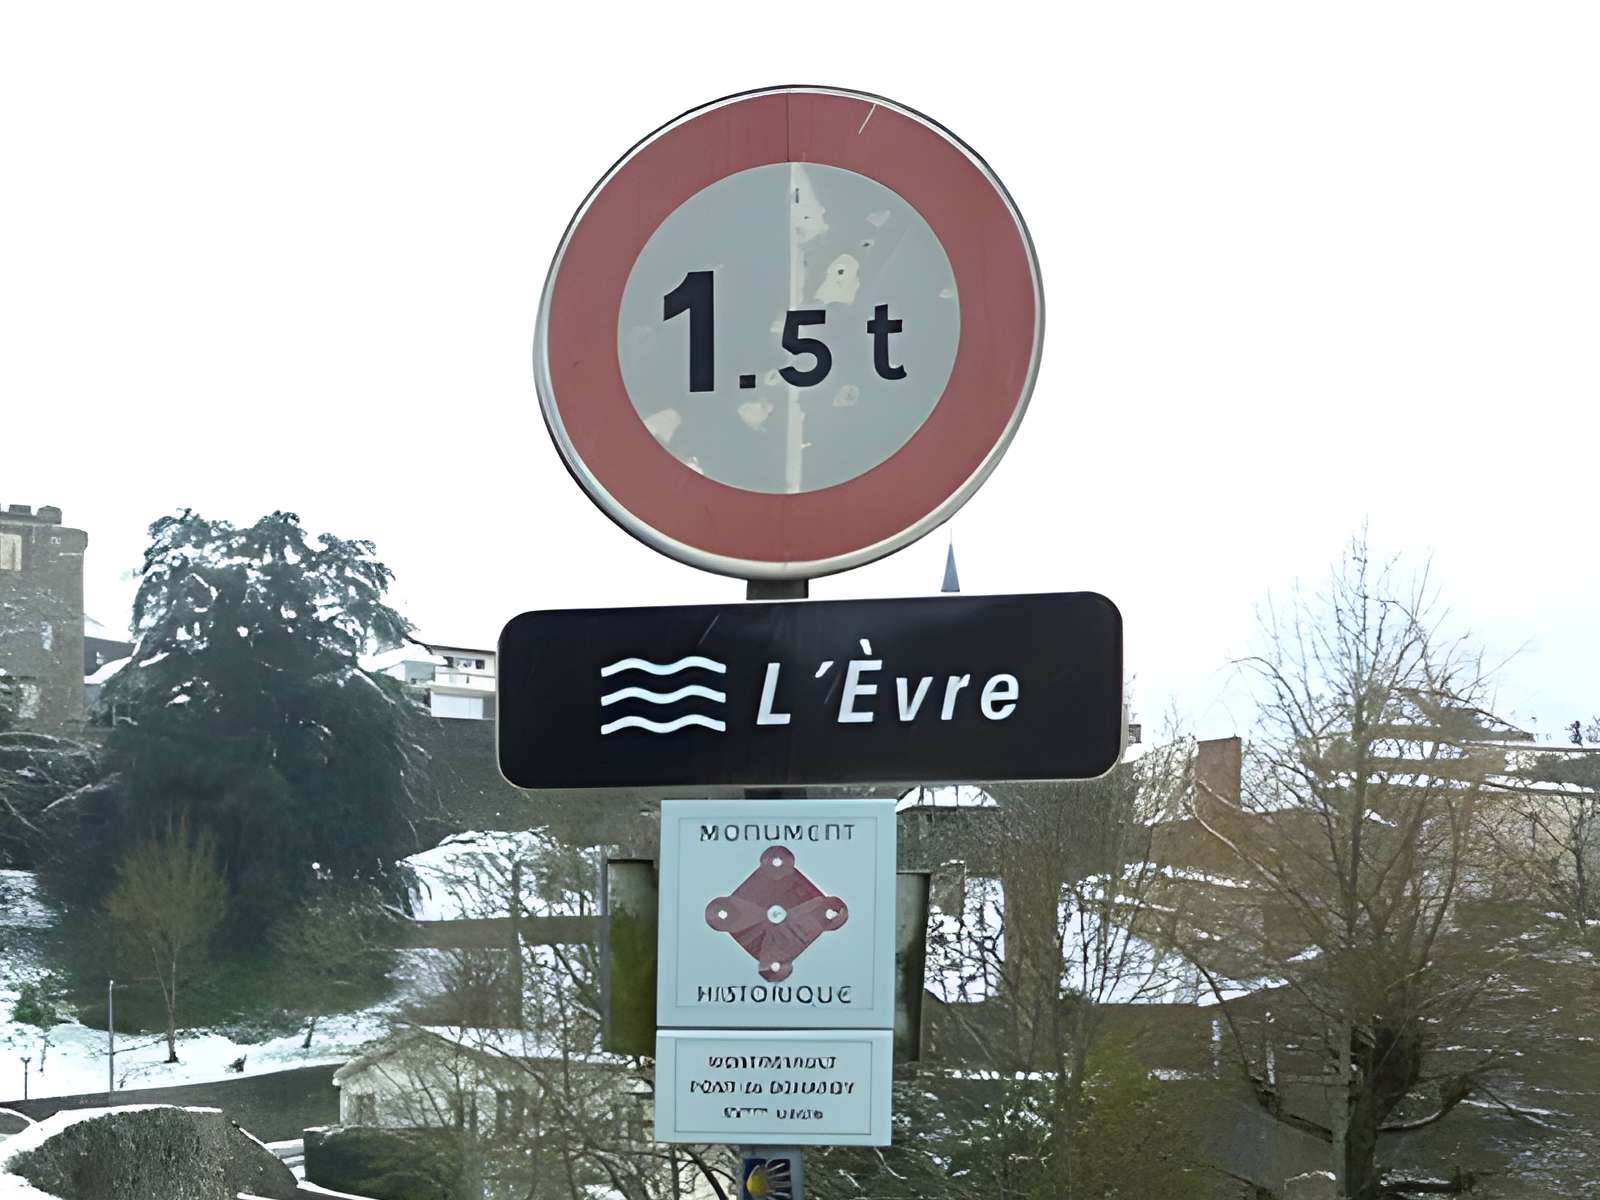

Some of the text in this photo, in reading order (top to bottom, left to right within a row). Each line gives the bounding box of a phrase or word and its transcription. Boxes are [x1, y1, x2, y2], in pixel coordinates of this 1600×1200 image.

[866, 303, 907, 381] t
[756, 638, 1020, 725] L'Èvre
[700, 824, 857, 842] MONUMENT
